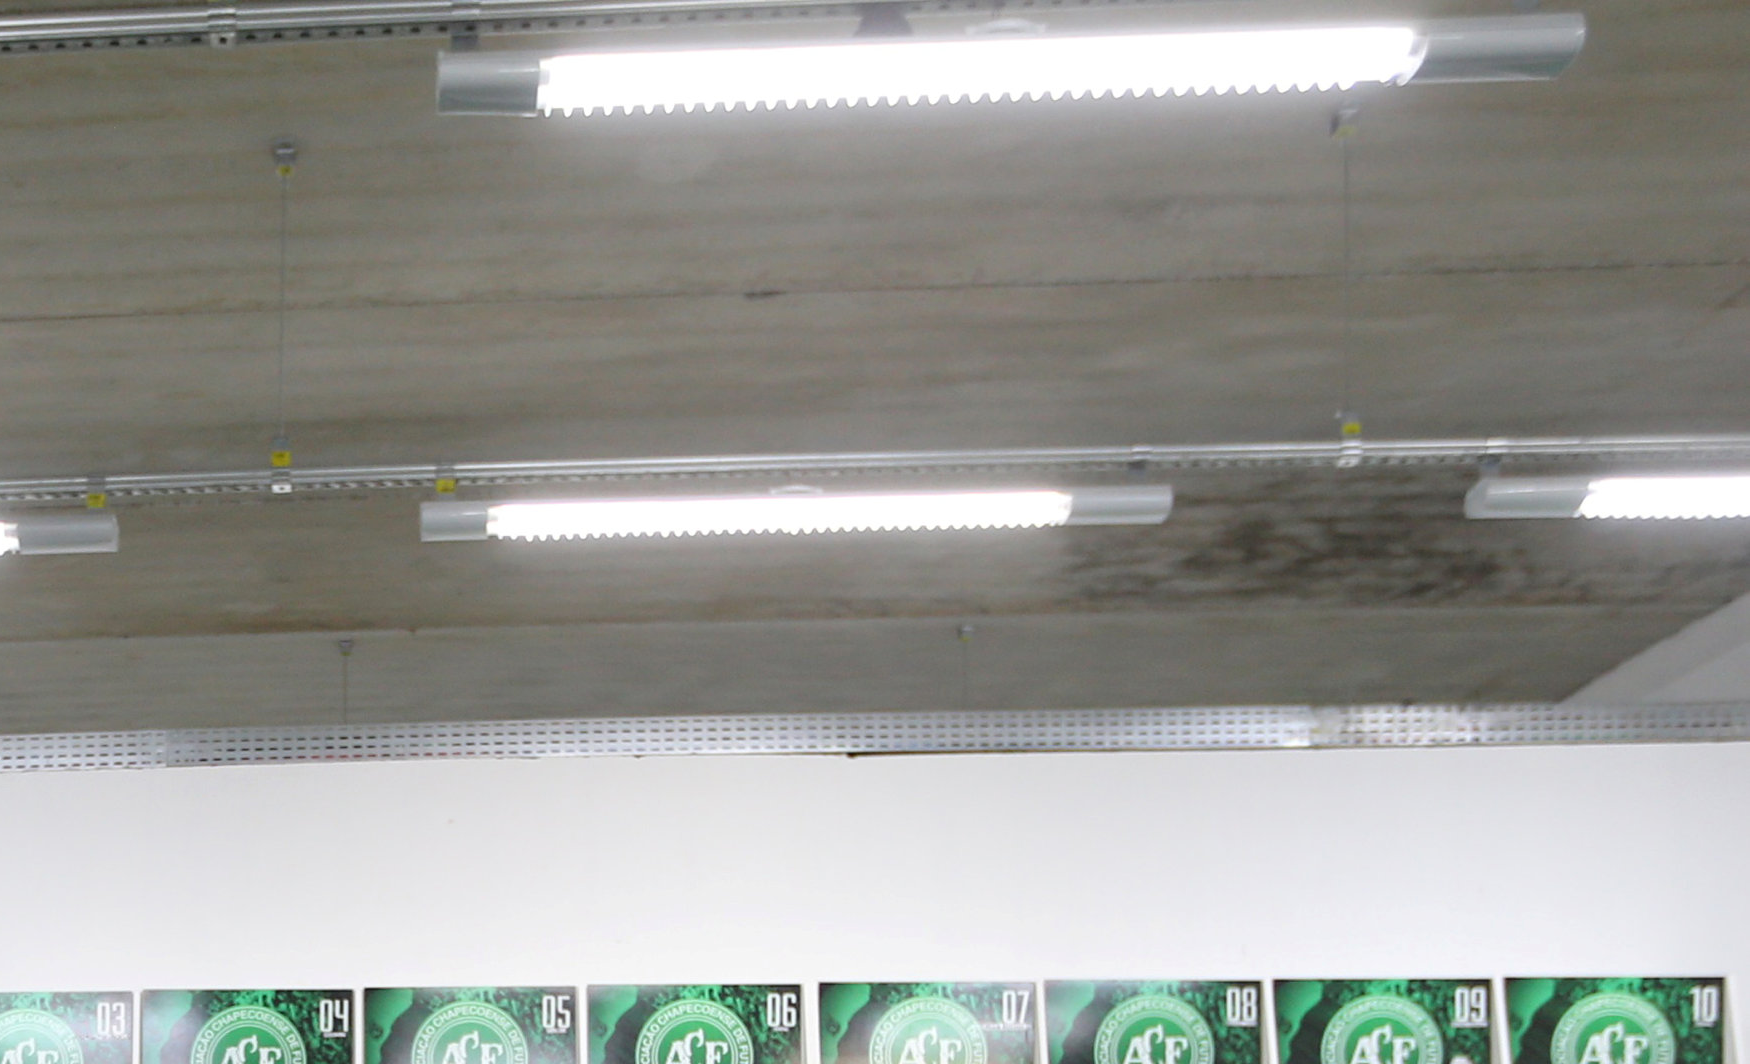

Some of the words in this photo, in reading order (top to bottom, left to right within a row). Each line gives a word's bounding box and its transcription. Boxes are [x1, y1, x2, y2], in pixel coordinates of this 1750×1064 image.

[97, 1002, 125, 1036] 03
[319, 1000, 348, 1032] 04
[433, 1006, 512, 1031] CHAPECOENSE
[542, 996, 570, 1029] 05
[658, 1004, 737, 1029] CHAPECOENSE
[767, 993, 796, 1028] 06
[1002, 990, 1029, 1024] 07
[1226, 987, 1257, 1022] 08
[1454, 987, 1487, 1023] 09
[1689, 985, 1719, 1023] 10
[212, 1010, 290, 1035] CHAPECOENSE
